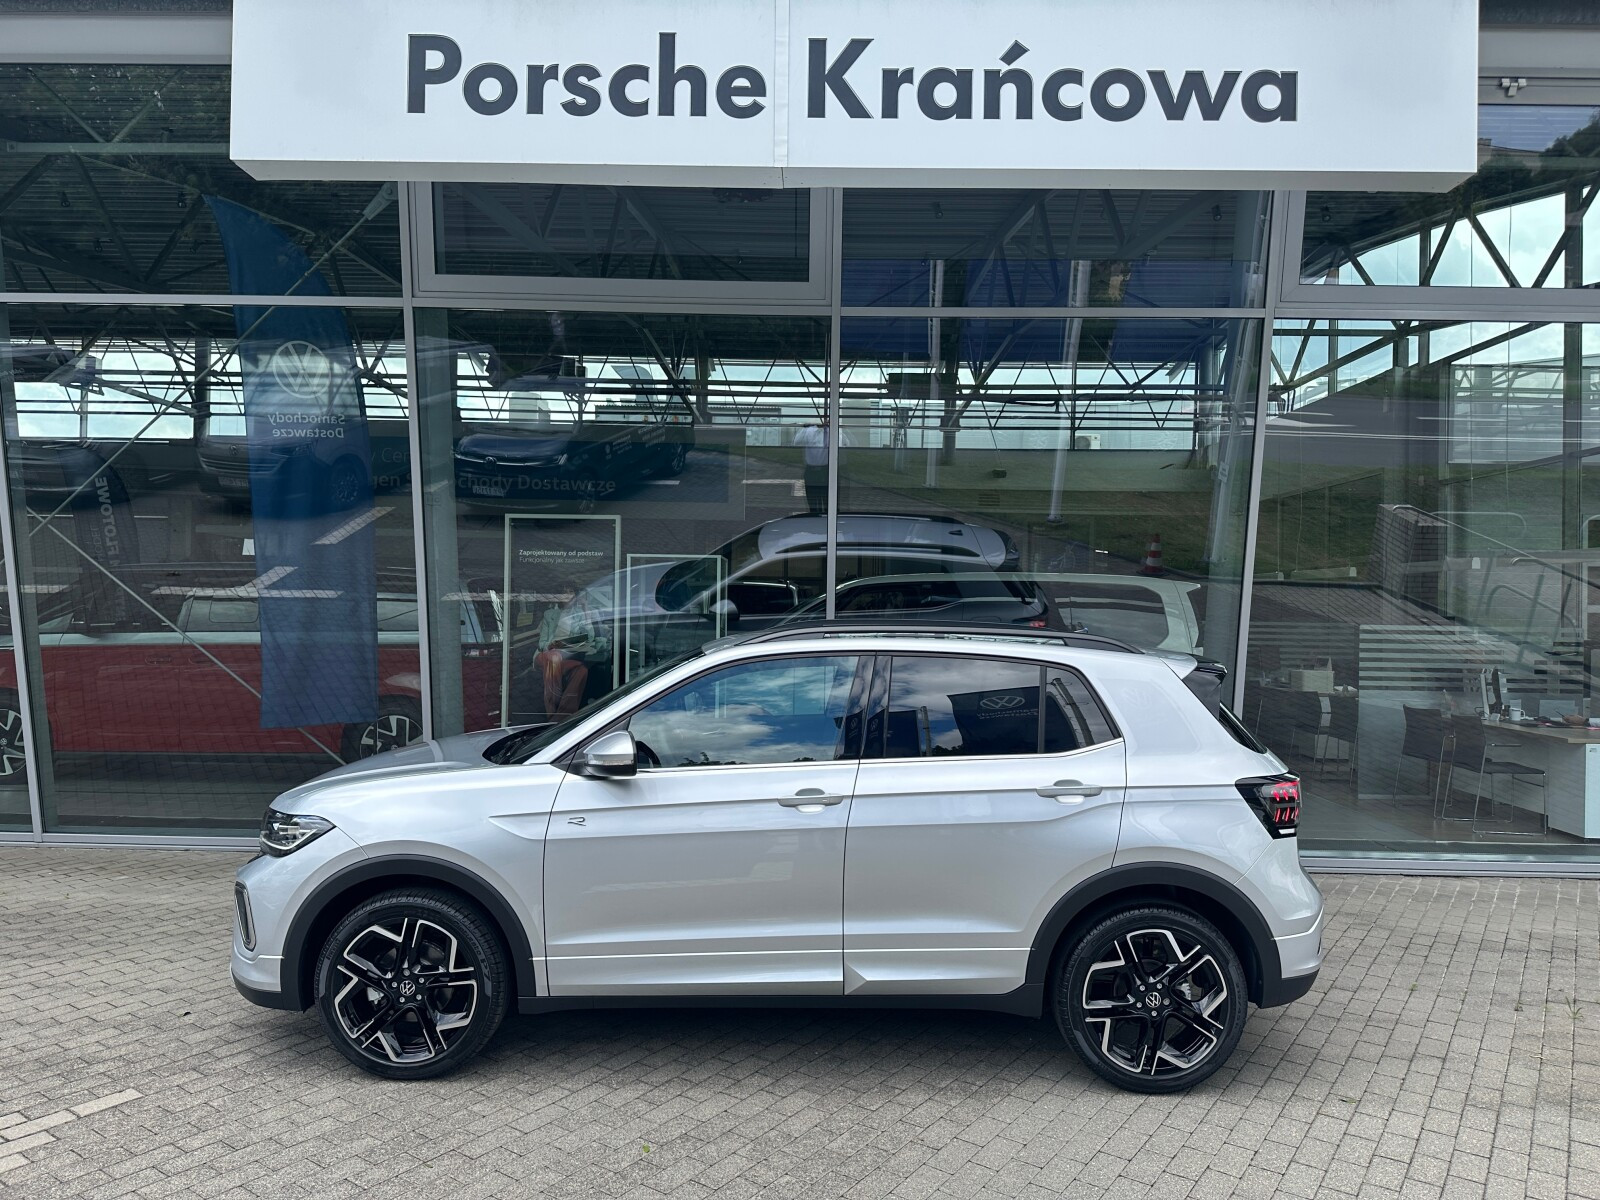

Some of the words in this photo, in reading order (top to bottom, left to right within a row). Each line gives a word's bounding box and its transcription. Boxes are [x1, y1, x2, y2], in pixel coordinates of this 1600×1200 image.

[407, 32, 767, 118] Porsche
[808, 38, 1299, 122] Krańcowa
[519, 549, 567, 557] Zaprojektowany
